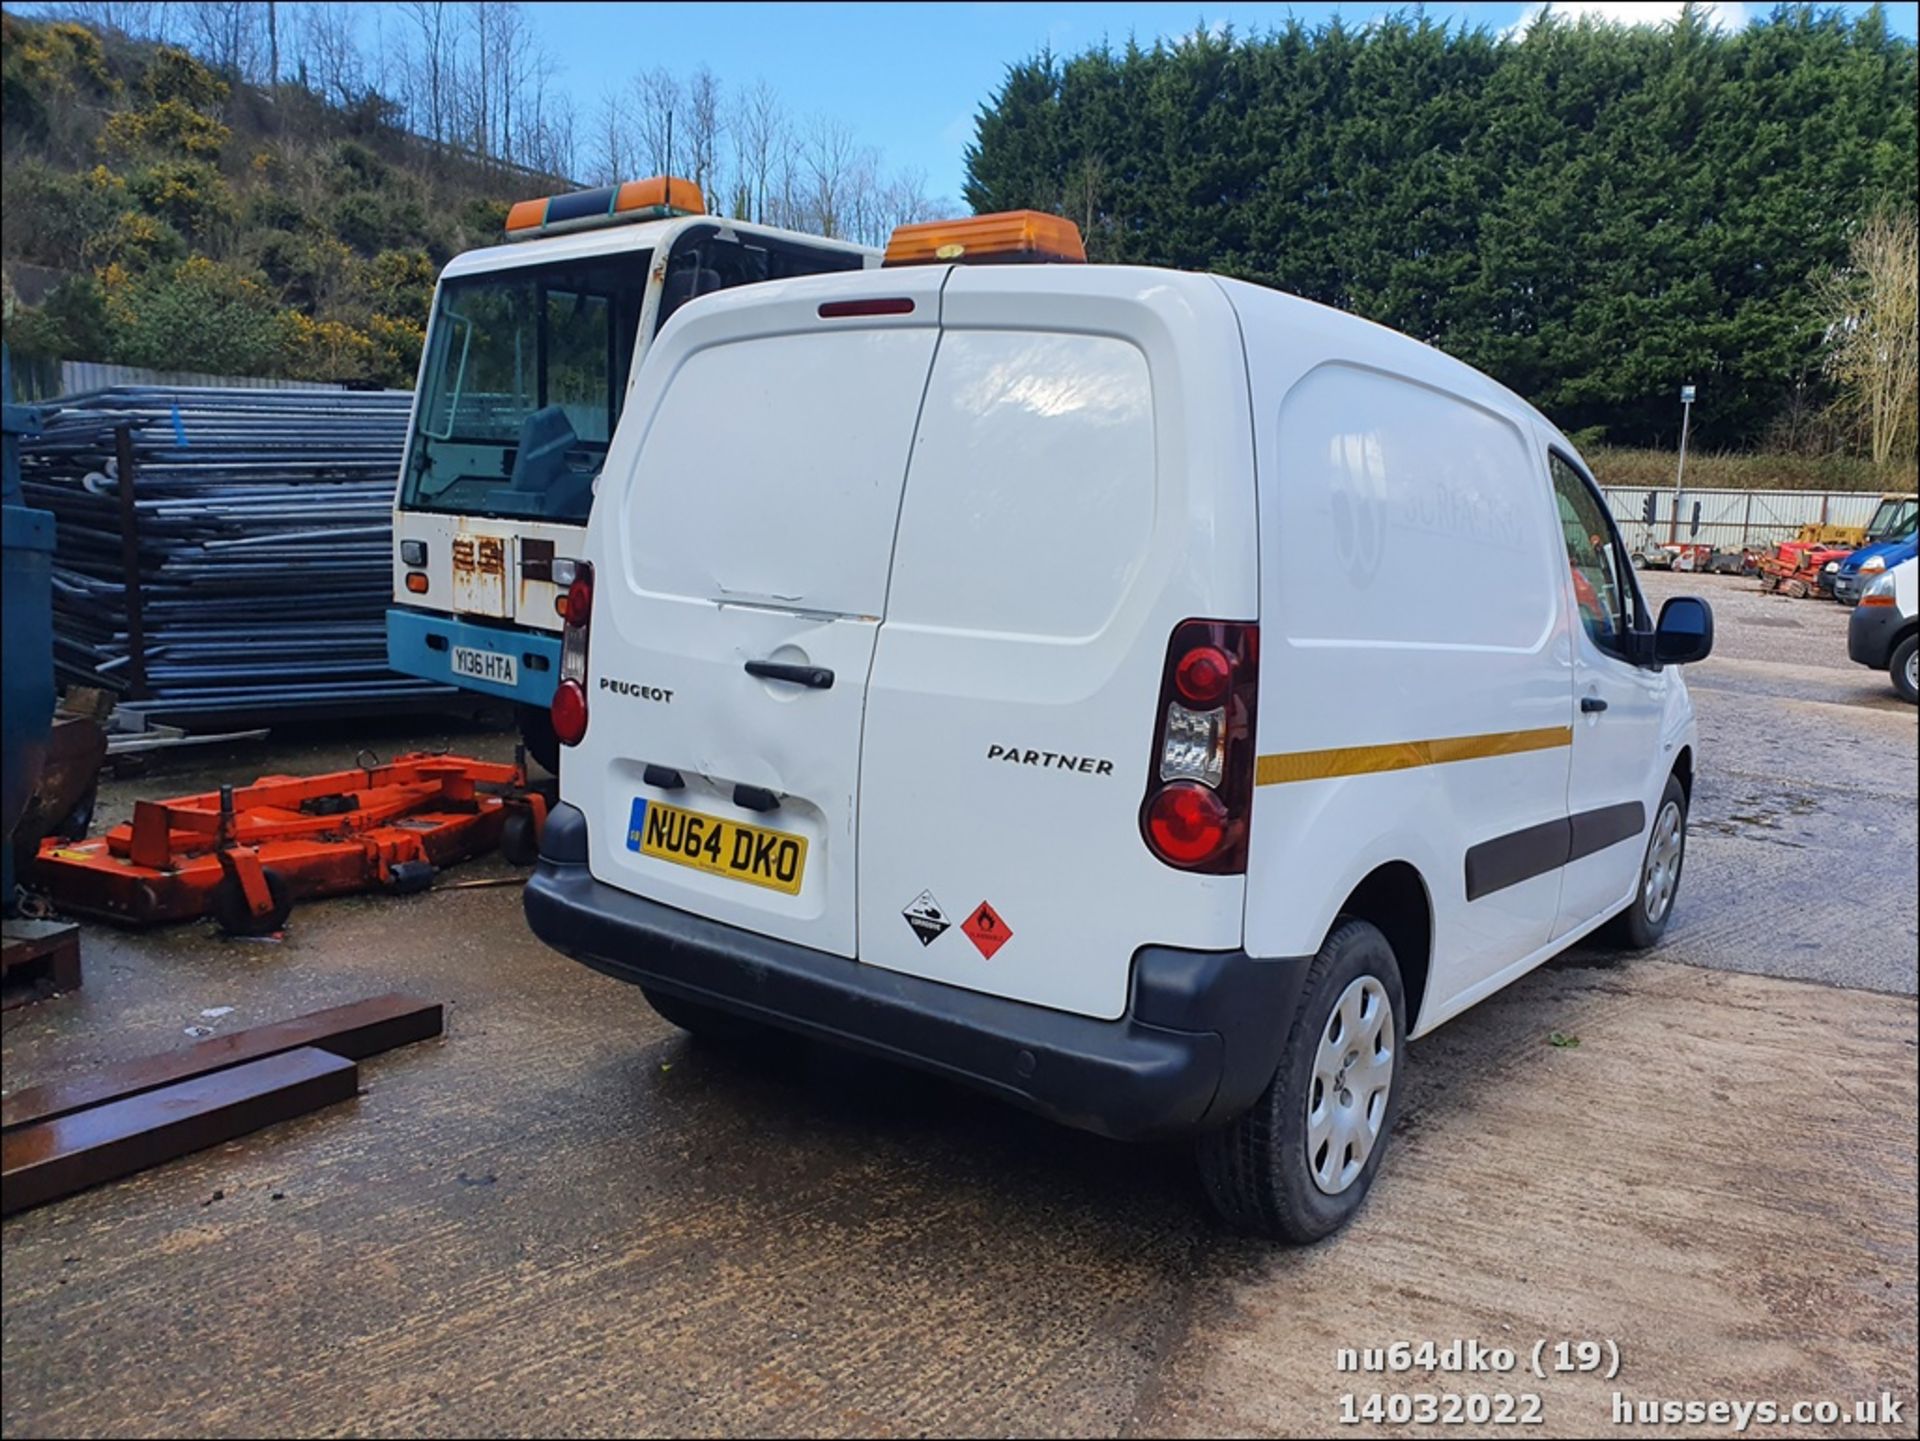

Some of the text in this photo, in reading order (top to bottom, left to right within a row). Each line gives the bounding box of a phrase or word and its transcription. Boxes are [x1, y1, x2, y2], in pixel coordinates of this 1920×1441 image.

[455, 648, 514, 681] Y136 HTA
[599, 677, 674, 704] PEUGEOT
[987, 744, 1114, 776] PARTNER
[646, 806, 800, 882] NU64 DKO
